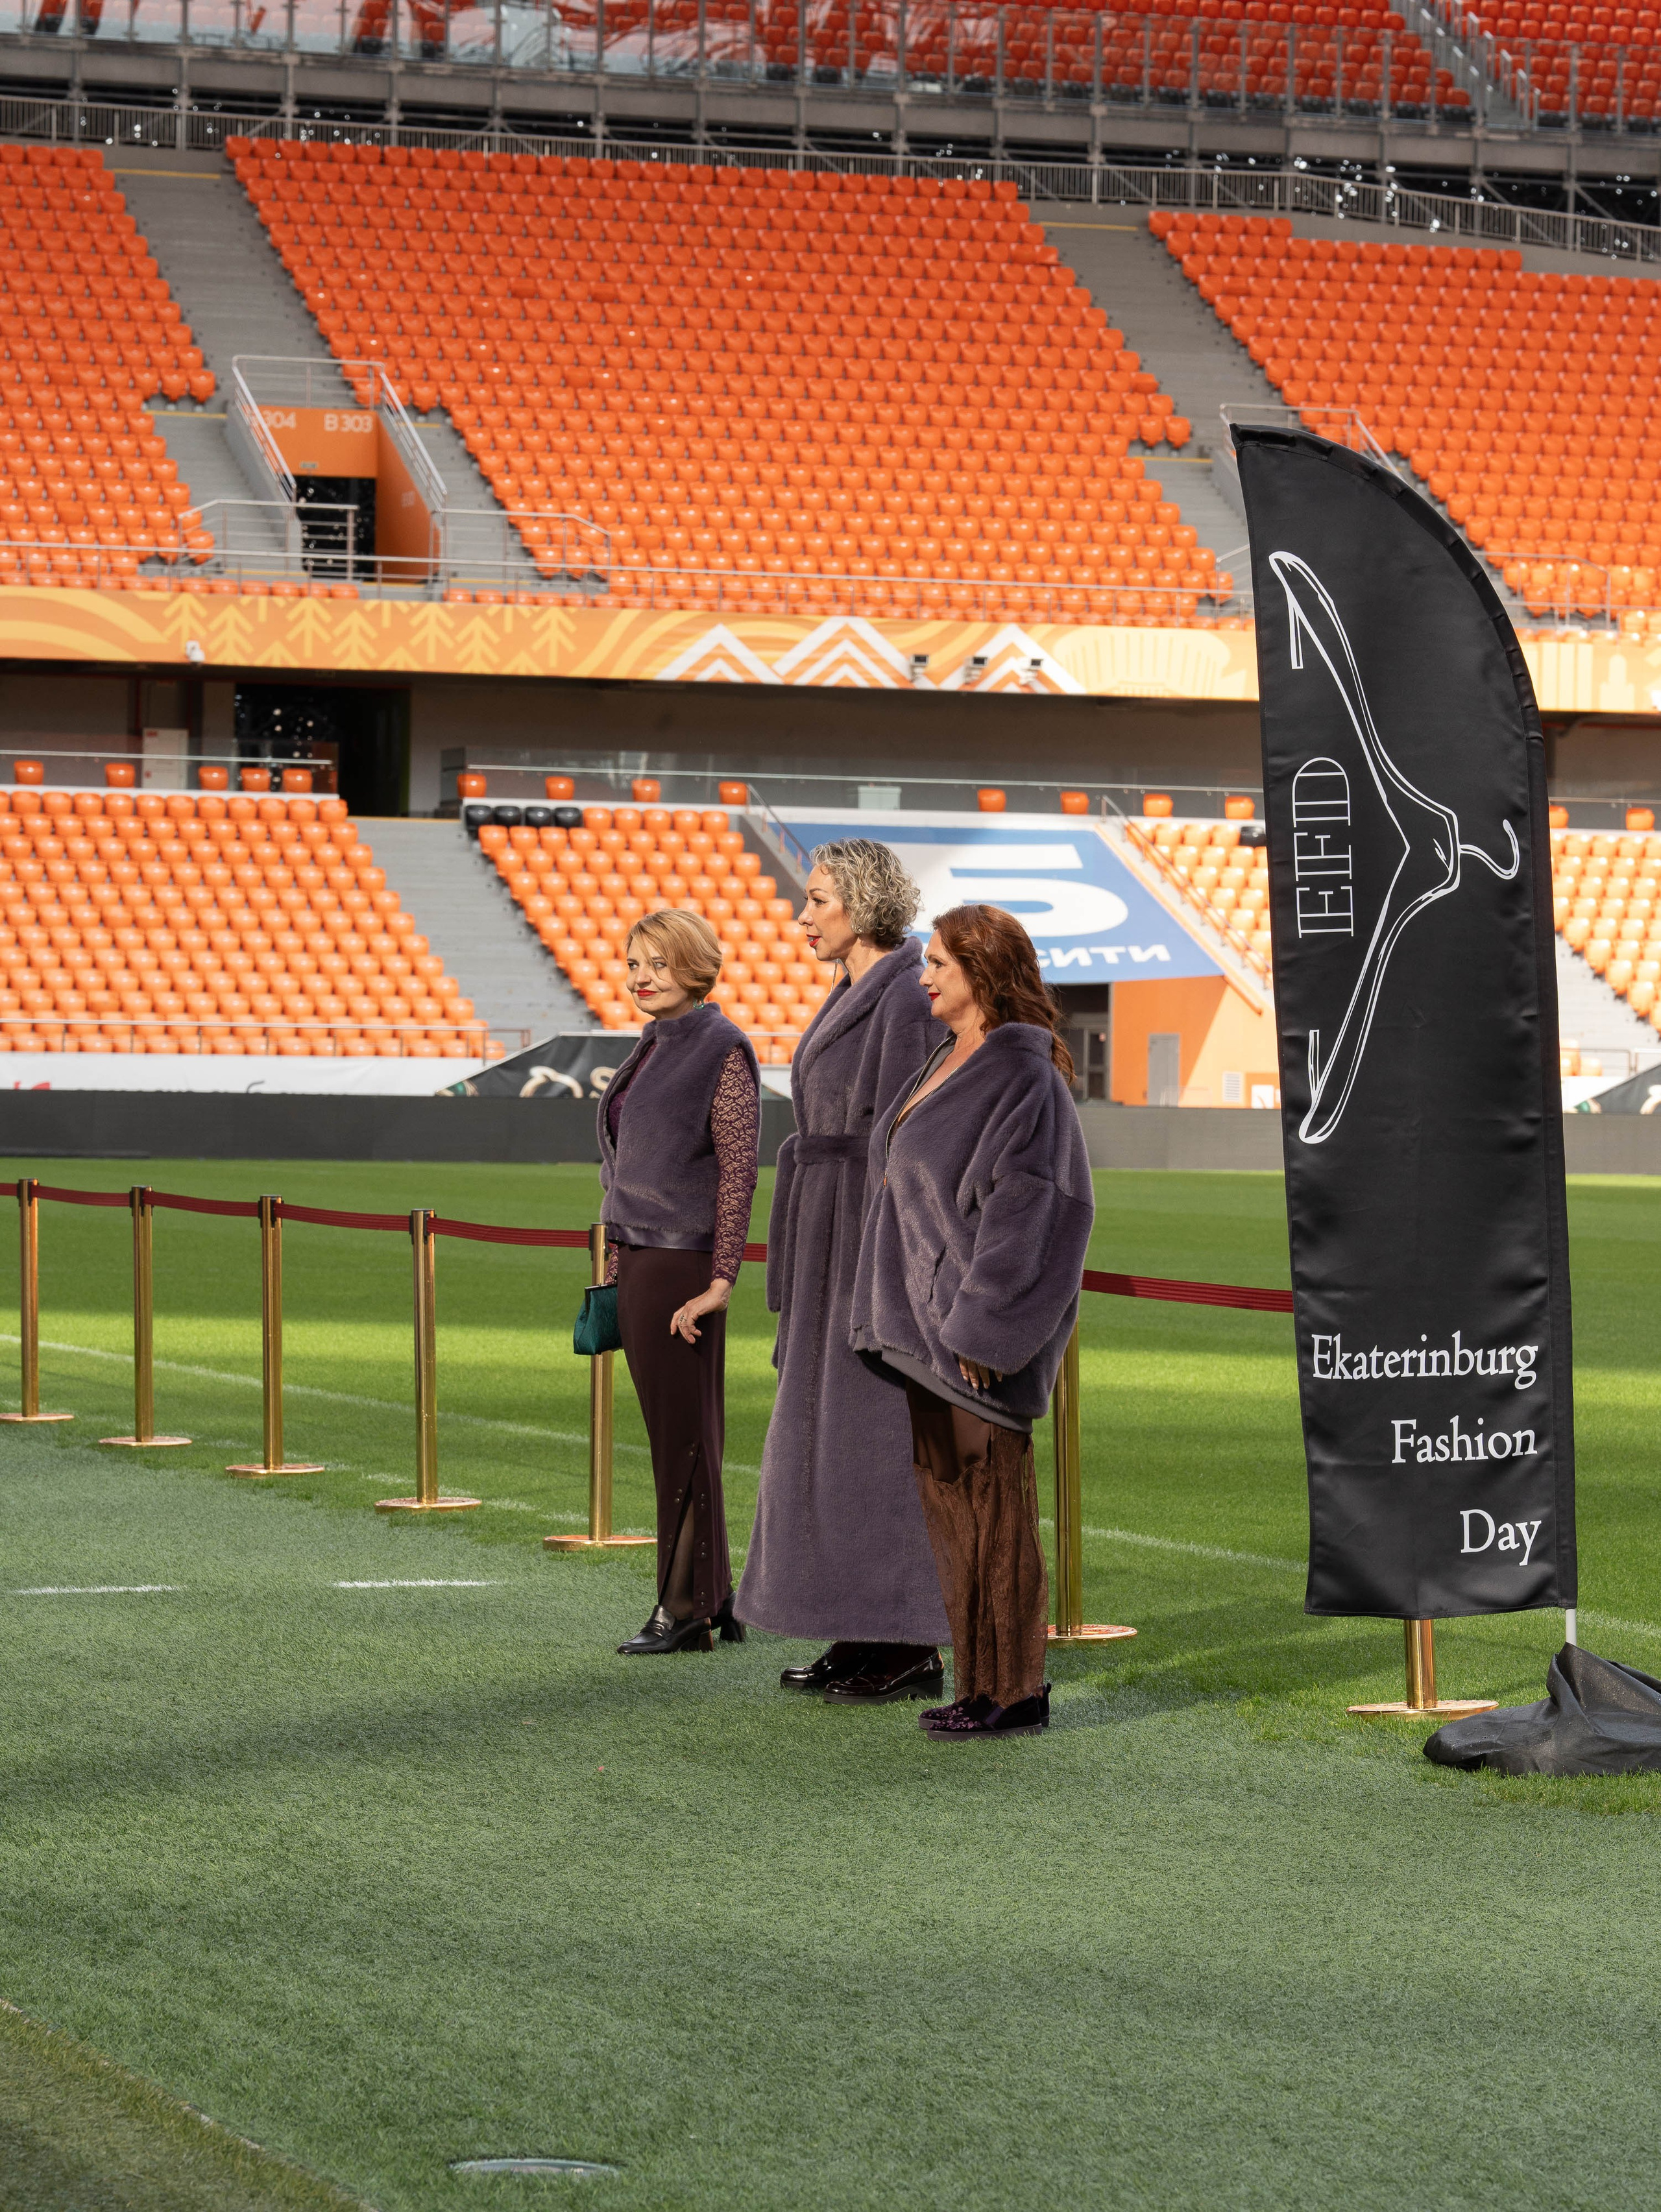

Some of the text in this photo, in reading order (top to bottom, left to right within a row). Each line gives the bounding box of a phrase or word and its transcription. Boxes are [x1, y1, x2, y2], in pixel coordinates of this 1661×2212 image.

[324, 414, 373, 433] B 303
[1292, 758, 1353, 938] EFD
[1312, 1330, 1538, 1389] Ekaterinburg
[1391, 1415, 1537, 1463] Fashion
[1461, 1509, 1541, 1566] Day
